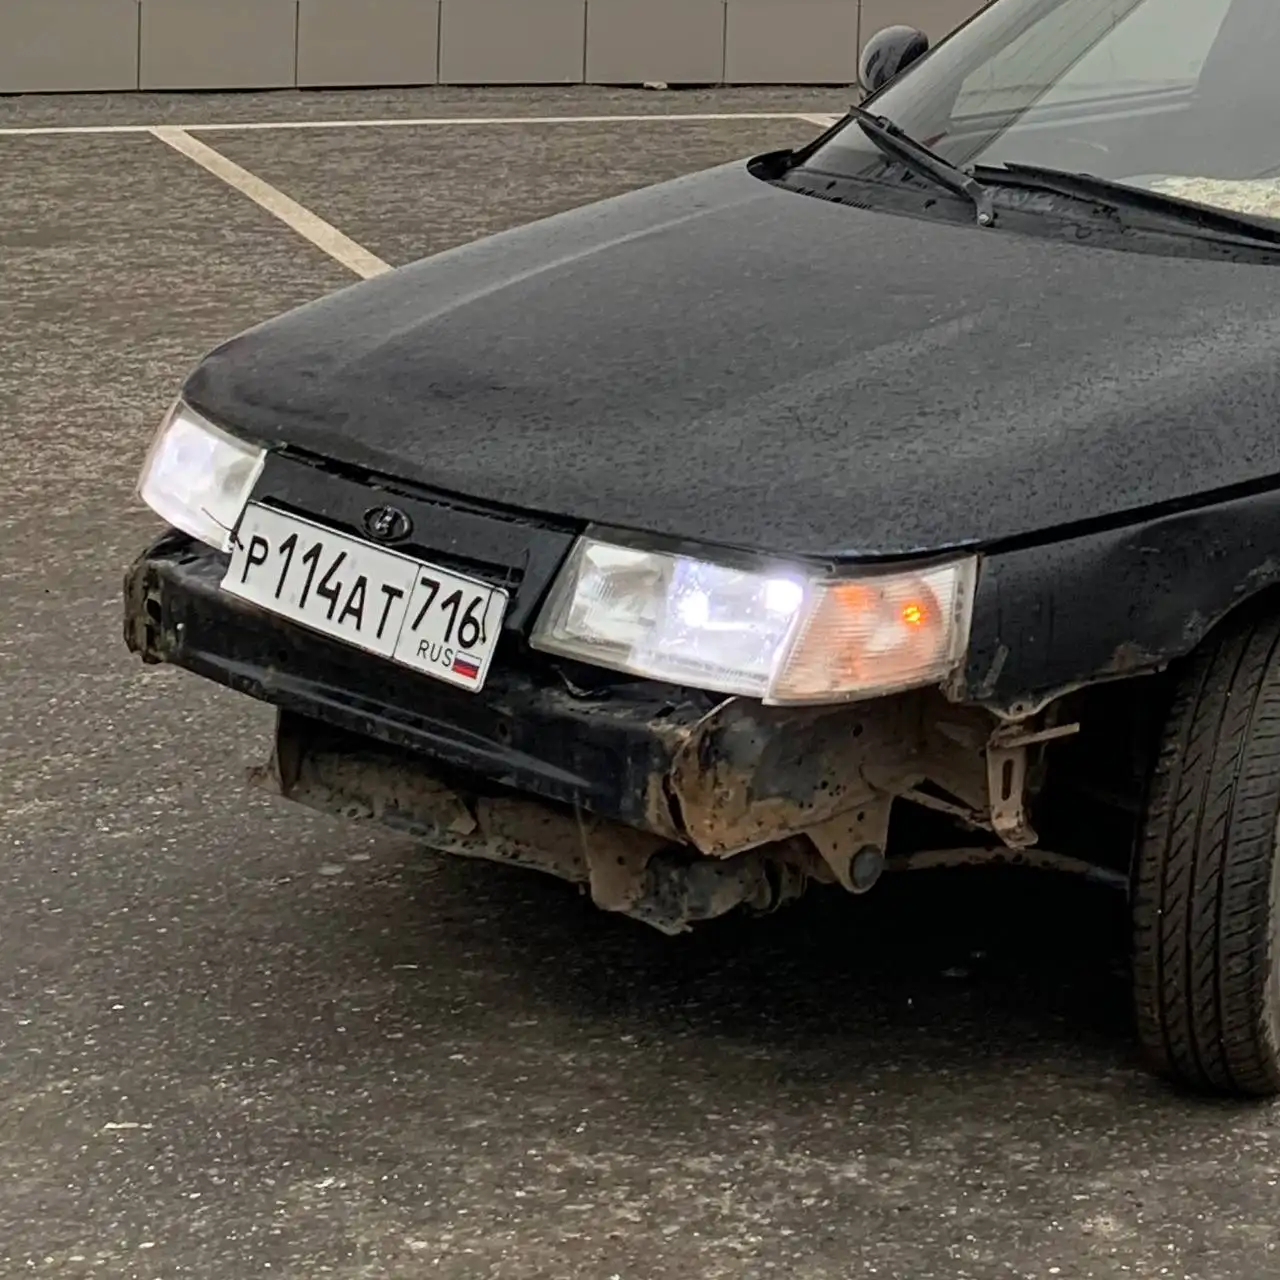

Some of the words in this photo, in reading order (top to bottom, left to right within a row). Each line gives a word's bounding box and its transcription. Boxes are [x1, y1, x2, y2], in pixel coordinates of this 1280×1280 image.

[240, 533, 403, 639] Р114АТ
[411, 577, 482, 649] 716
[416, 639, 453, 668] RUS
